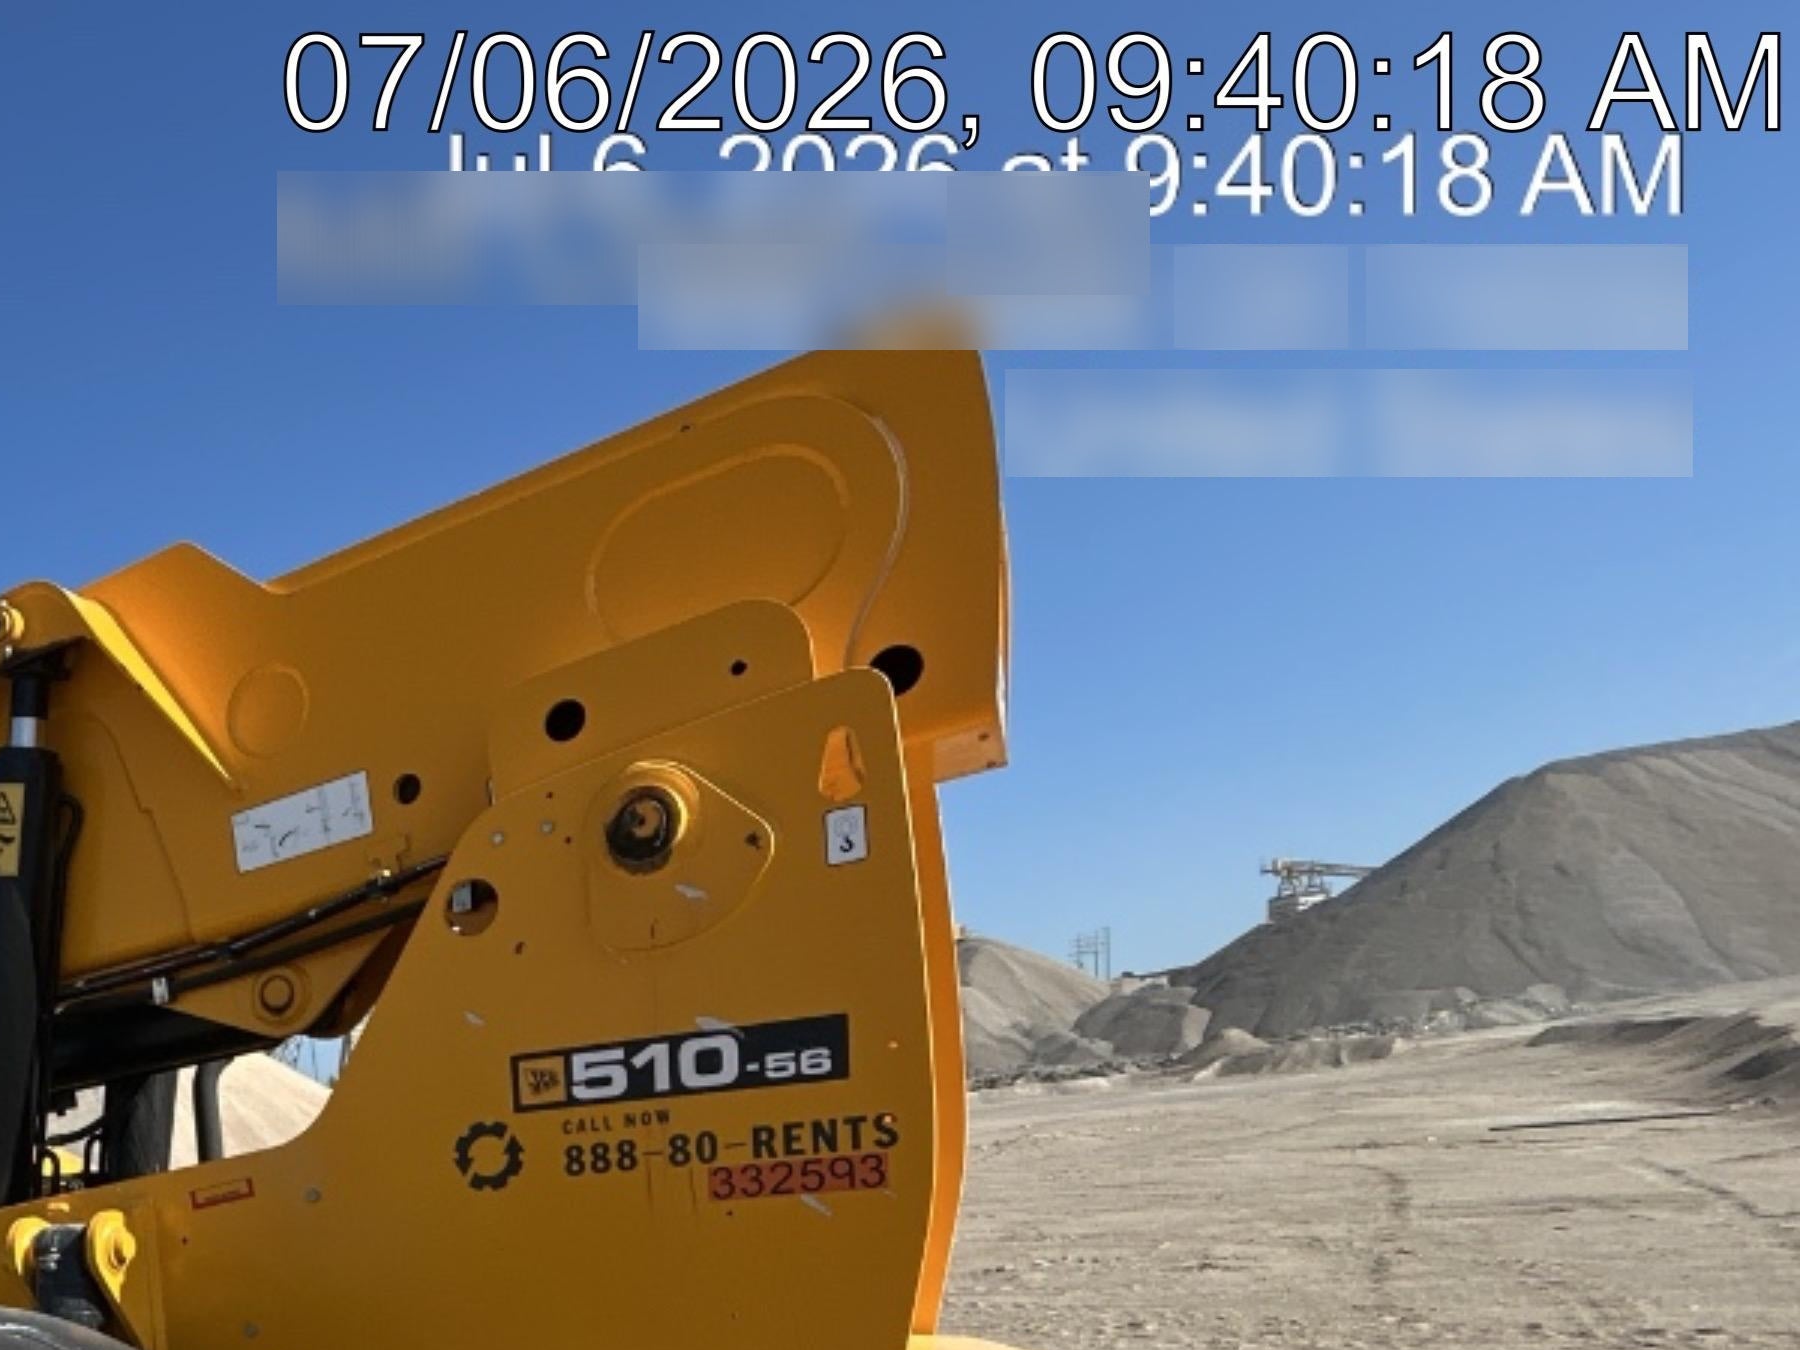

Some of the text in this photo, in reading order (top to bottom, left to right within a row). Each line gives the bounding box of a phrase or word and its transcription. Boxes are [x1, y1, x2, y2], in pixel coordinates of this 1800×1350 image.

[571, 1034, 833, 1100] 510-56
[562, 1109, 671, 1135] CALL NOW
[711, 1153, 888, 1200] 332593
